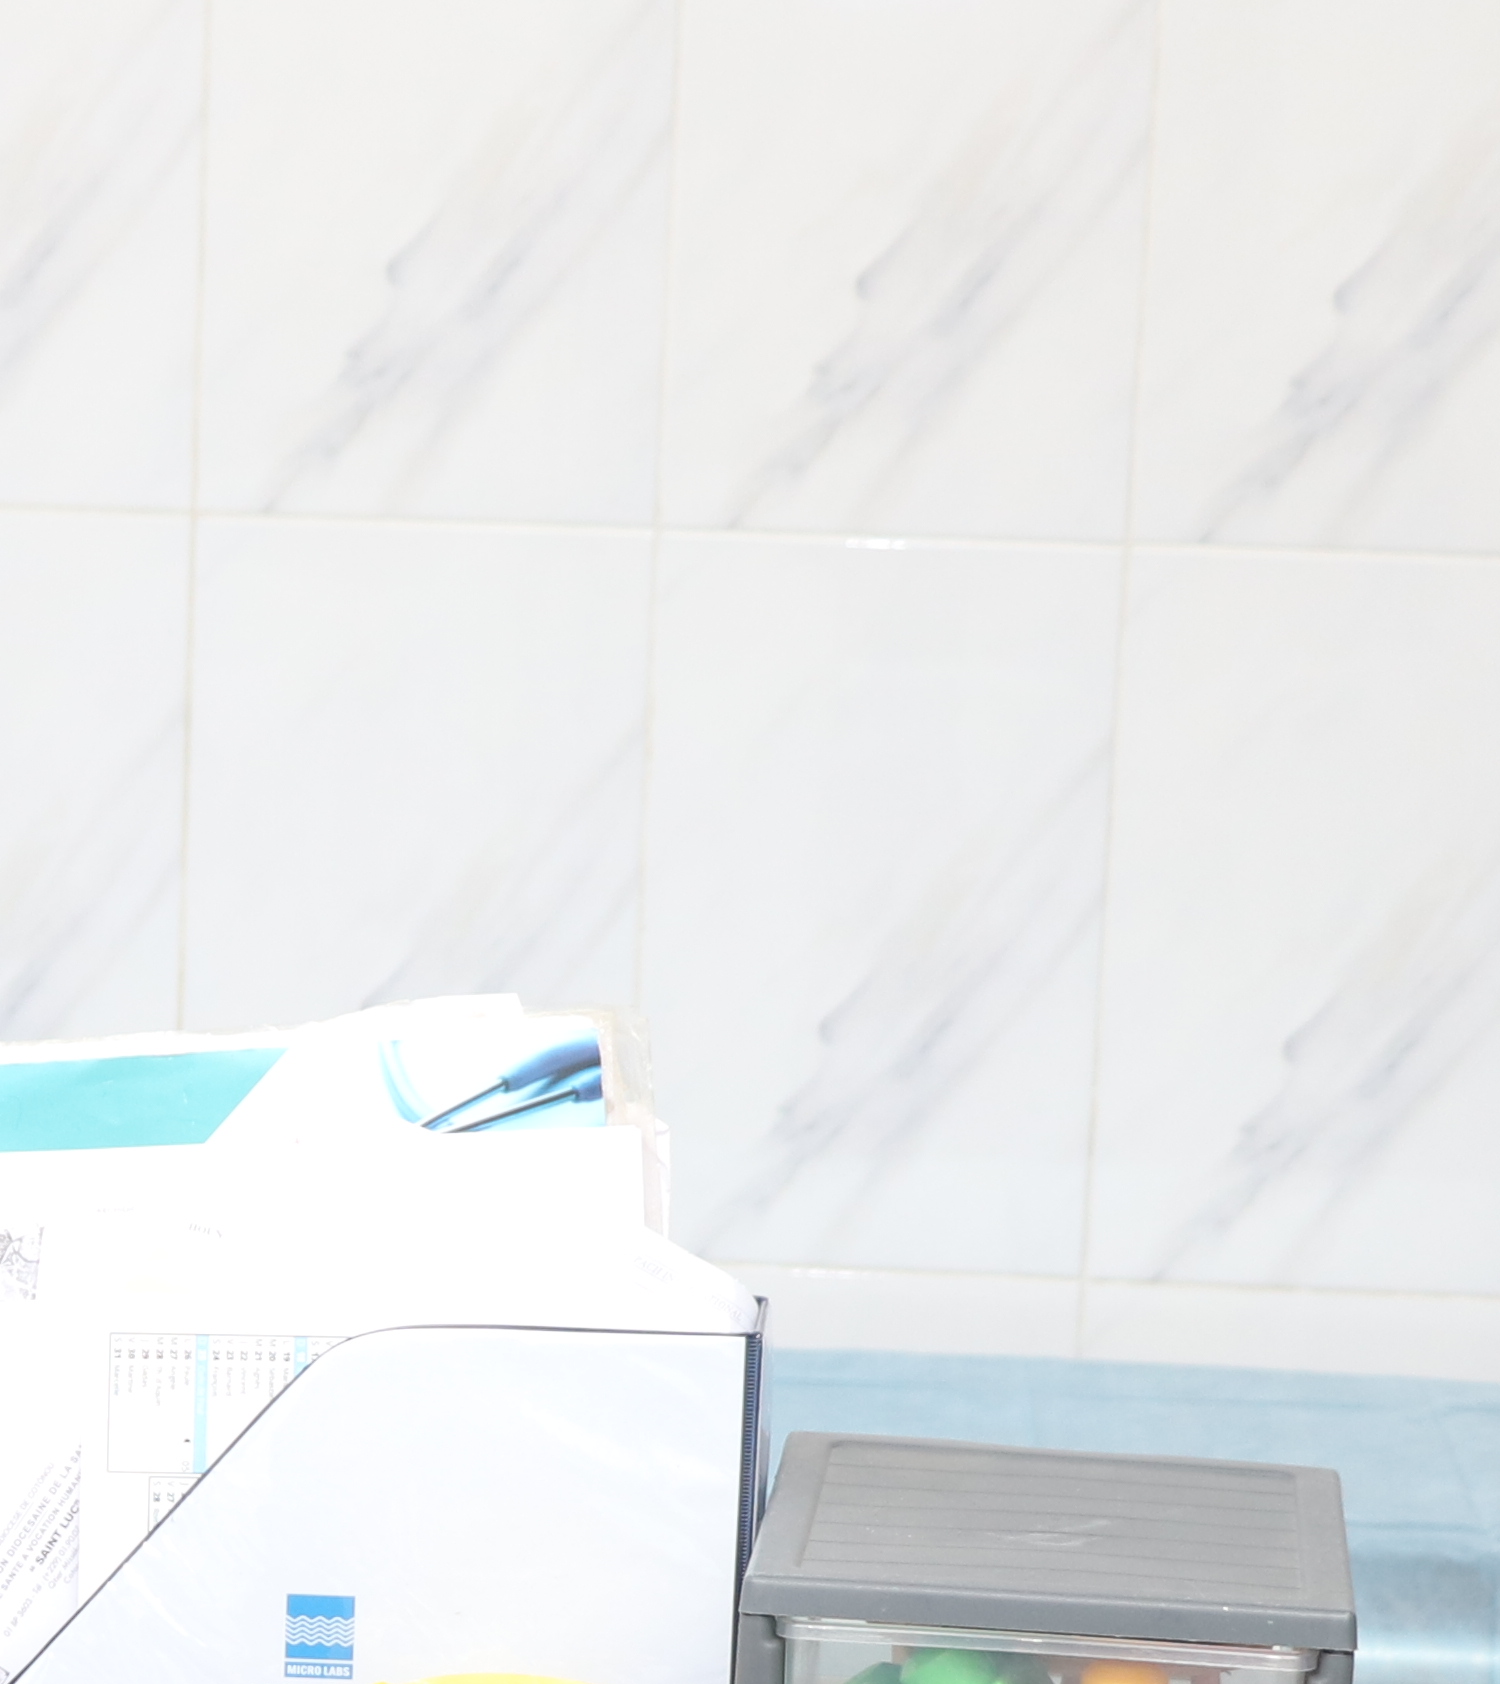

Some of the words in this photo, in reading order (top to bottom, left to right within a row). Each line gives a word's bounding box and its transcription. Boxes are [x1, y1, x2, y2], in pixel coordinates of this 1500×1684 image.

[5, 1494, 51, 1557] DIOCESAINE
[47, 1479, 62, 1495] DE
[58, 1463, 72, 1479] LA
[0, 1560, 24, 1591] SANTE
[25, 1506, 60, 1553] VOCATION
[33, 1527, 64, 1566] SAINT
[286, 1664, 322, 1676] MICRO
[323, 1665, 350, 1677] LABS
